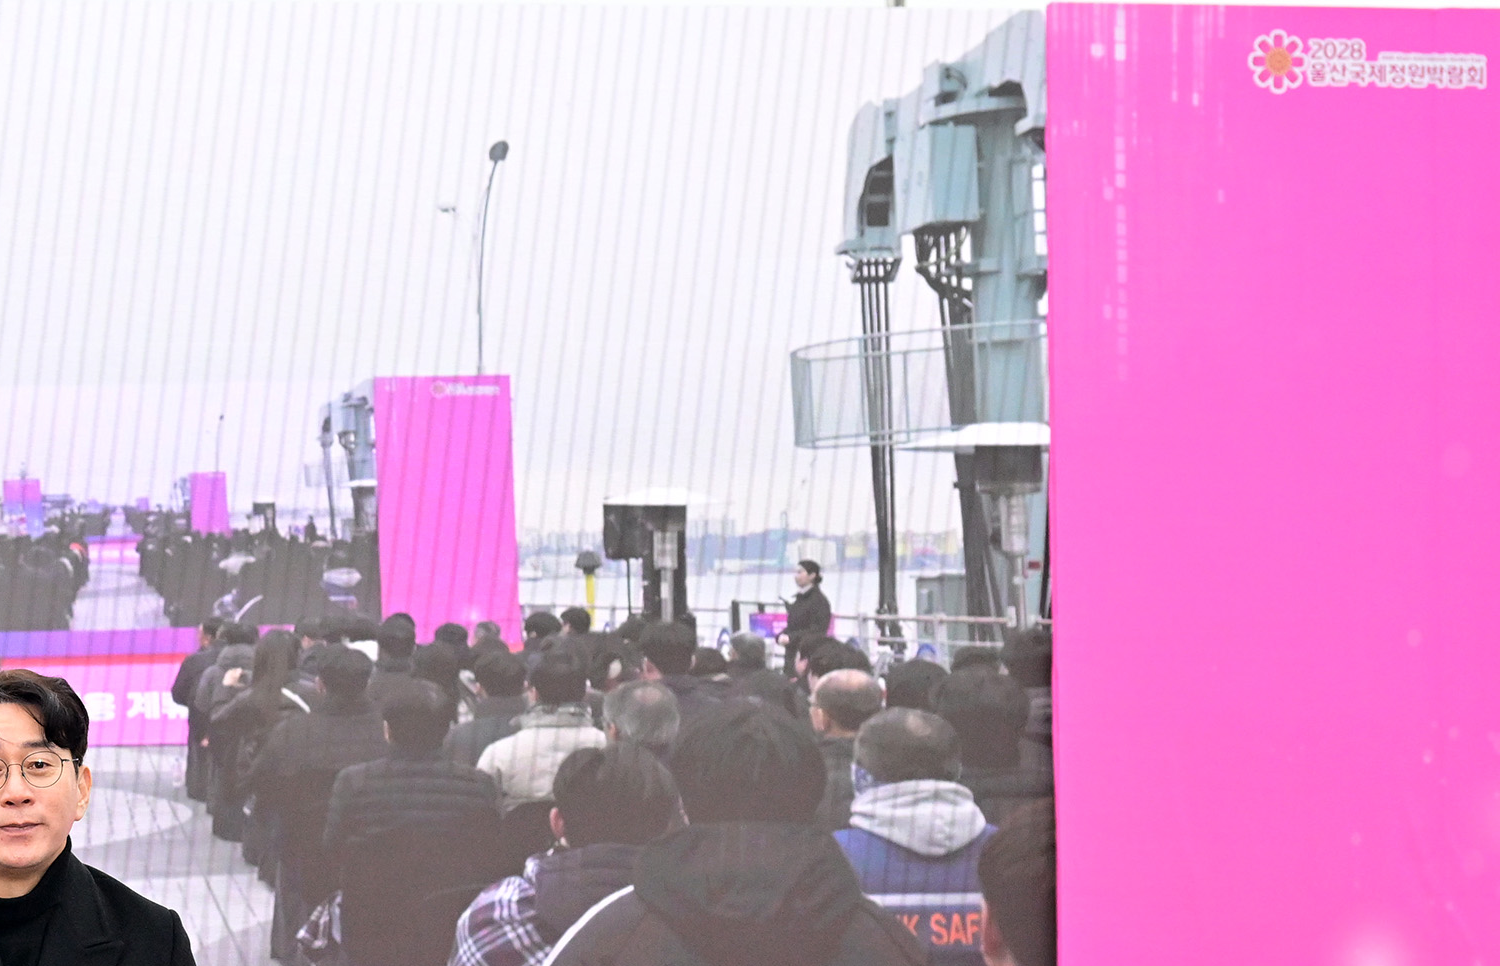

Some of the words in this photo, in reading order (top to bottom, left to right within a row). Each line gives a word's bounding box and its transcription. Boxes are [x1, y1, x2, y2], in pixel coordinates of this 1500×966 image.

[1310, 40, 1363, 60] 2028
[1310, 62, 1484, 86] 울산국제정원박람회
[77, 691, 115, 722] 용
